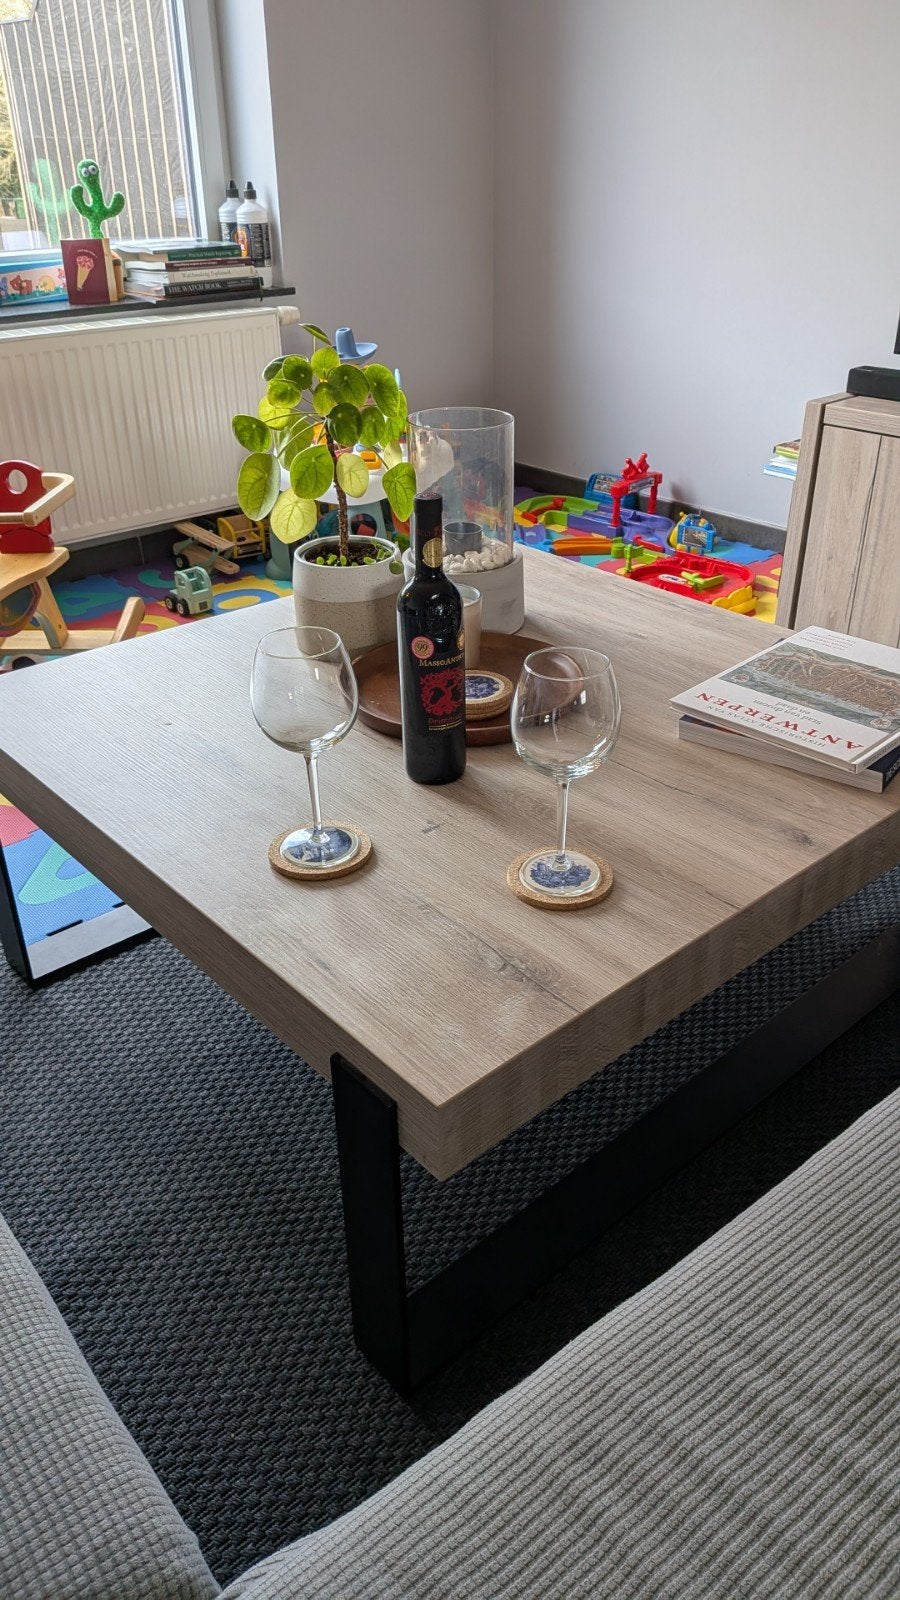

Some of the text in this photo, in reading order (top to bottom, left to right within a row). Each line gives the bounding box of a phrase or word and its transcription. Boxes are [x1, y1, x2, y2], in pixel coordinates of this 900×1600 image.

[182, 284, 203, 292] WATCH
[203, 282, 221, 290] BOOK
[694, 692, 865, 749] ANTWERPEN
[706, 704, 827, 748] HISTORISCHE ATLAS VAN
